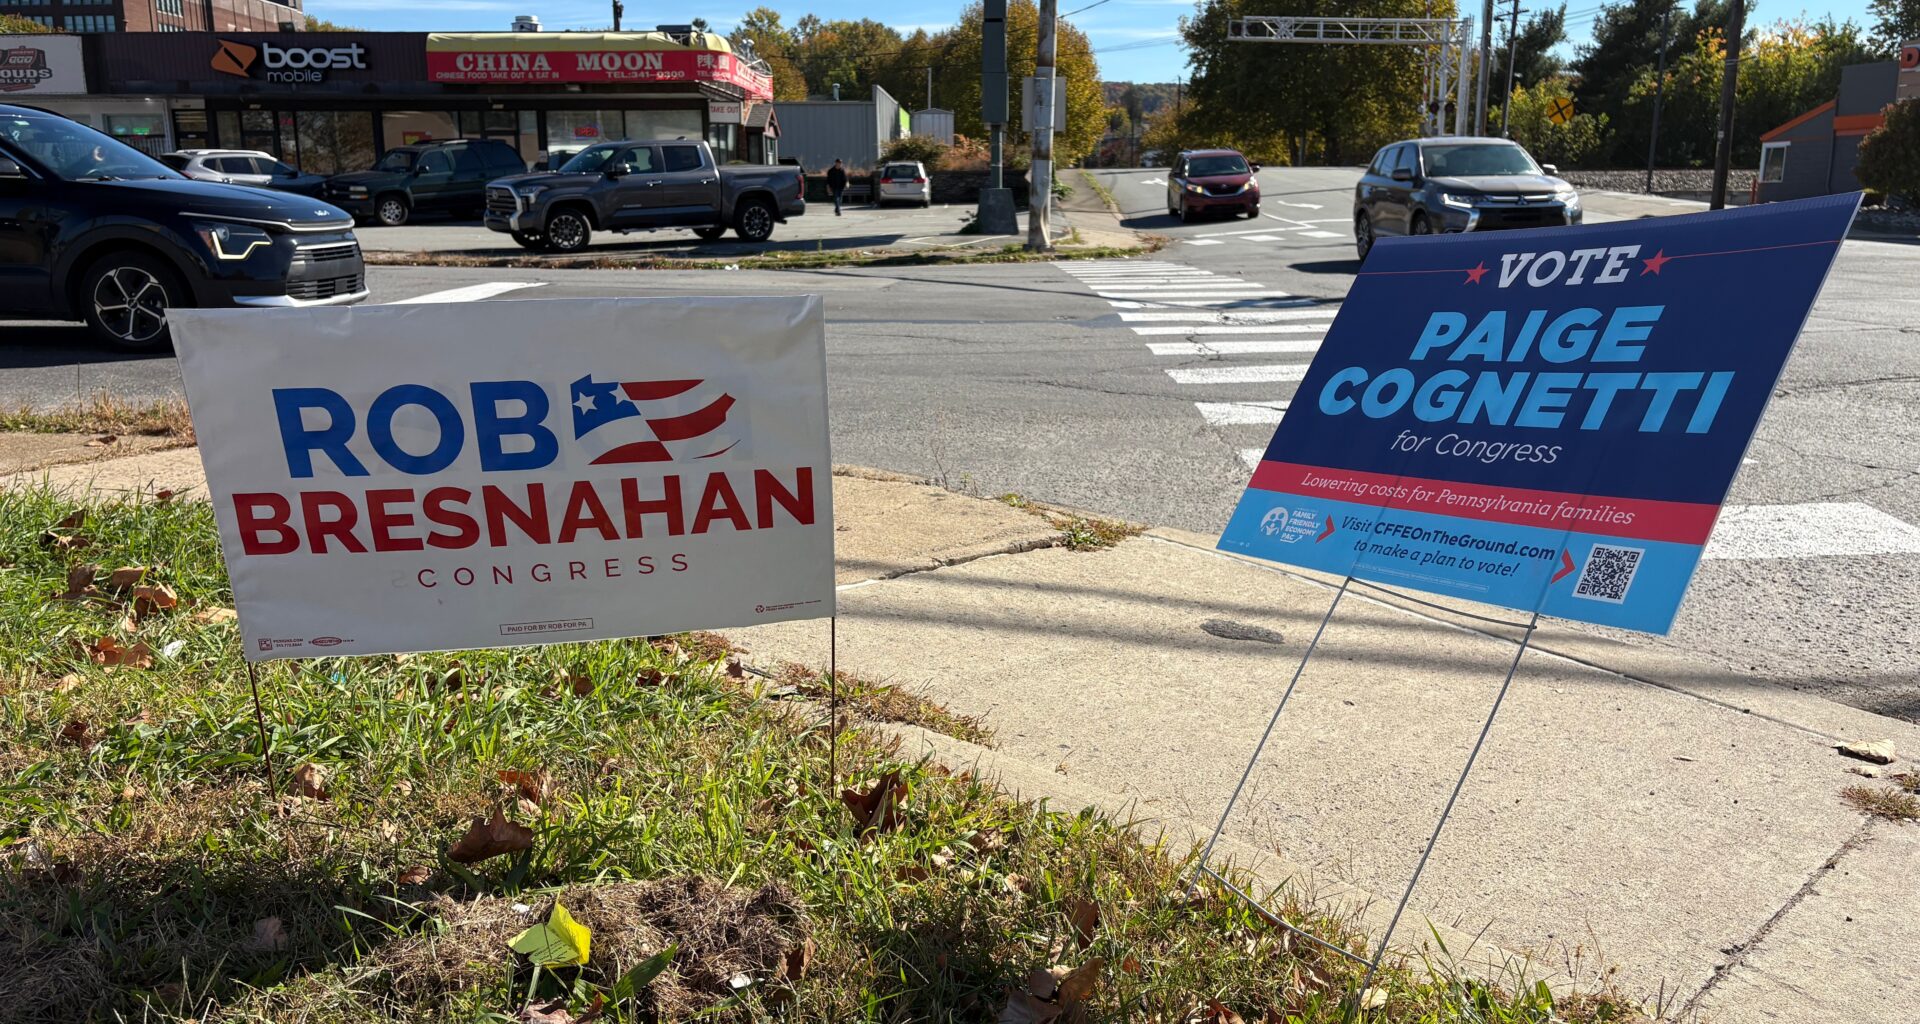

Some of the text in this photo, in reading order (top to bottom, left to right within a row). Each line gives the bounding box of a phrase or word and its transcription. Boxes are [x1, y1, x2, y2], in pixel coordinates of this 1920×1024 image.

[263, 42, 366, 69] boost
[456, 52, 664, 71] CHINA MOON
[267, 70, 322, 82] mobile
[1498, 245, 1642, 288] VOTE
[1409, 305, 1666, 364] PAIGE
[1318, 366, 1735, 434] COGNETTI
[271, 380, 559, 478] ROB
[1390, 429, 1563, 464] for Congress
[232, 466, 815, 556] BRESNAHAN
[1292, 510, 1316, 520] FAMILY
[1301, 472, 1636, 525] Lowering costs for Pennsylvania families
[1281, 532, 1294, 541] PAC
[1284, 526, 1317, 537] ECONOMY
[1288, 518, 1321, 529] FRIENDLY
[1341, 516, 1556, 561] Visit CFFEOnTheGround.com
[417, 553, 689, 588] CONGRESS
[1354, 538, 1521, 577] to make a plan to vote!
